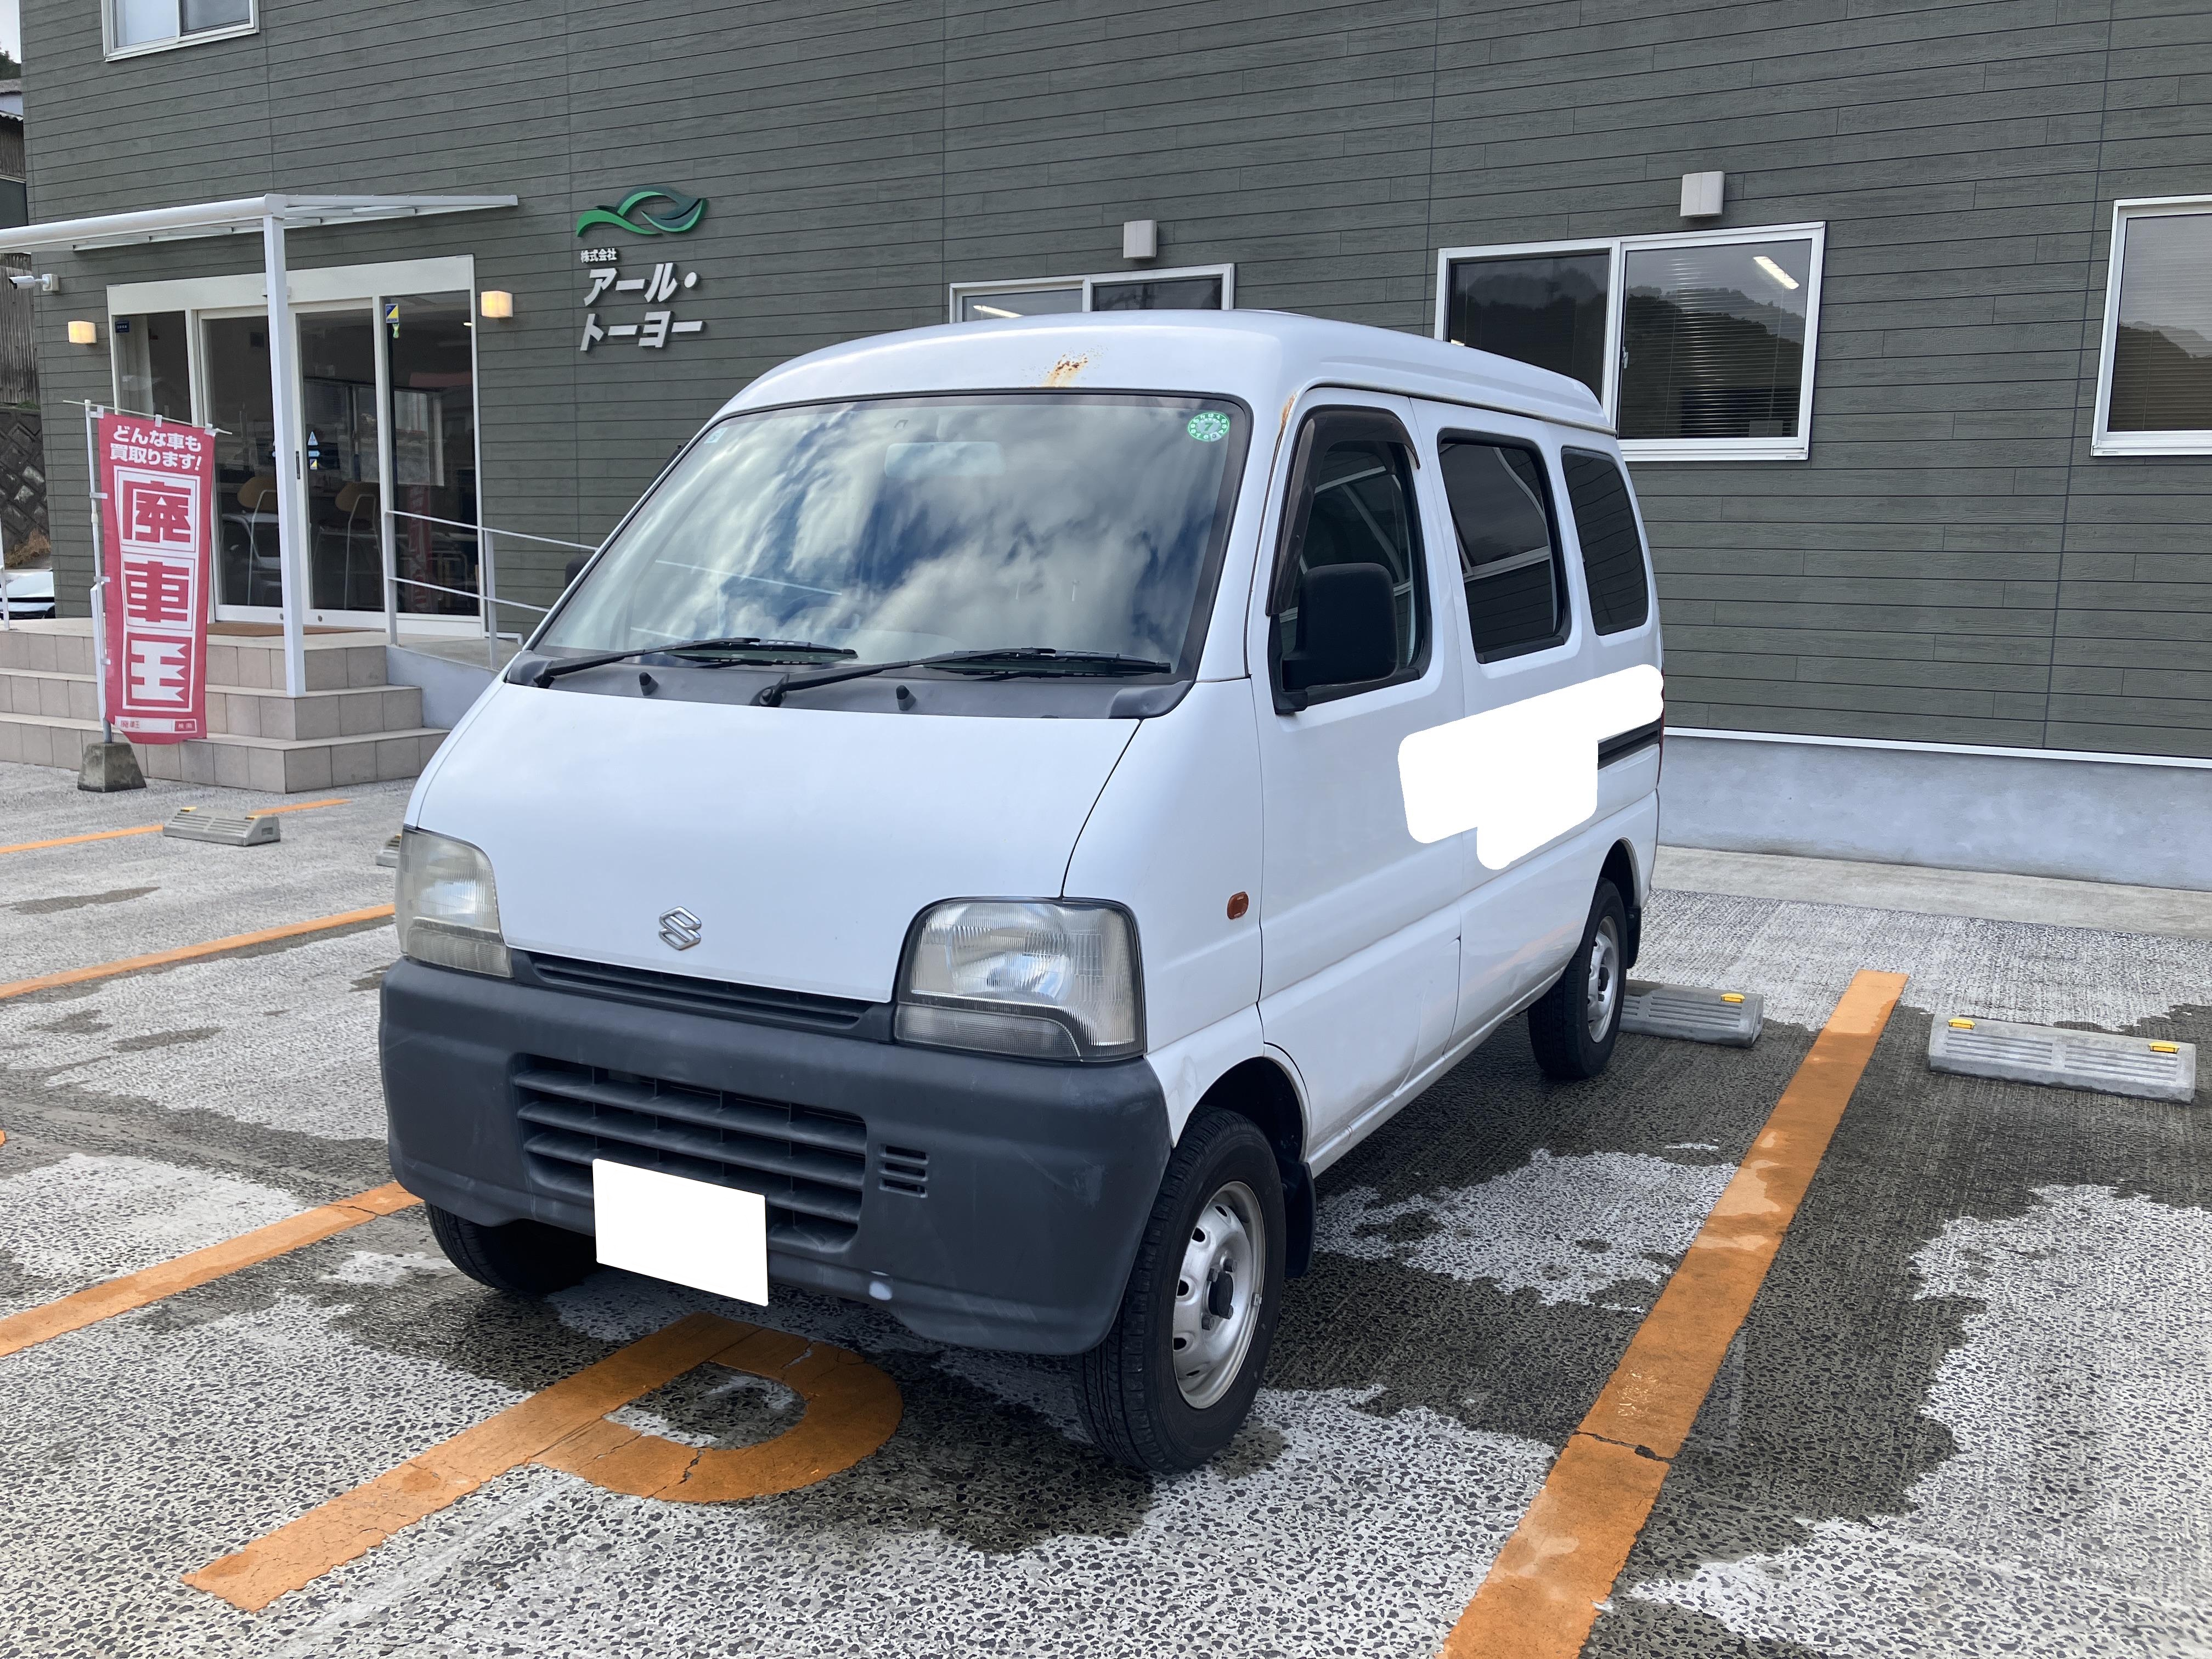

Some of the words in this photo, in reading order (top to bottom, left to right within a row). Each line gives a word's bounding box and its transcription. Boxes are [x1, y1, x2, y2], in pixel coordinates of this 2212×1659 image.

[580, 248, 617, 263] 株式会社
[584, 263, 698, 307] アール・
[580, 311, 703, 351] トーヨー
[113, 425, 201, 453] どんな車も
[1205, 422, 1213, 431] 7
[110, 443, 202, 471] 買取ります!
[122, 479, 191, 702] 廃車王
